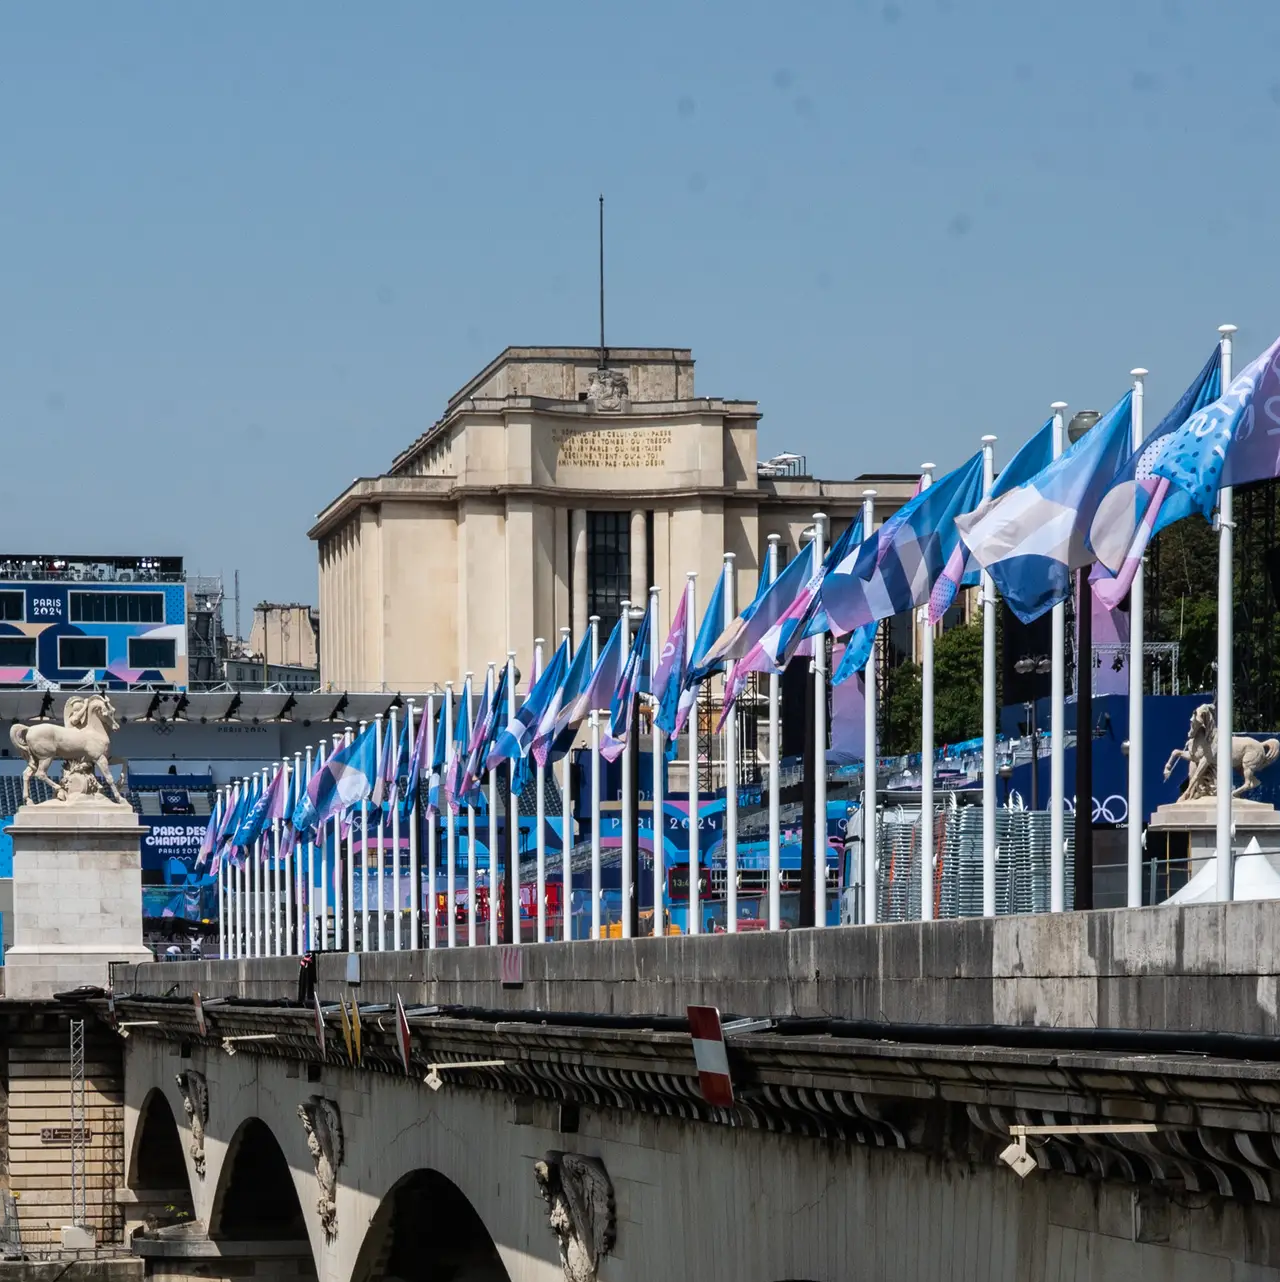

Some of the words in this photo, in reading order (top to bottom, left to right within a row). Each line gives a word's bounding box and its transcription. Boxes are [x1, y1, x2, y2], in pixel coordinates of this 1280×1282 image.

[33, 607, 62, 616] 2024
[152, 826, 184, 836] PARC
[186, 826, 207, 836] DES
